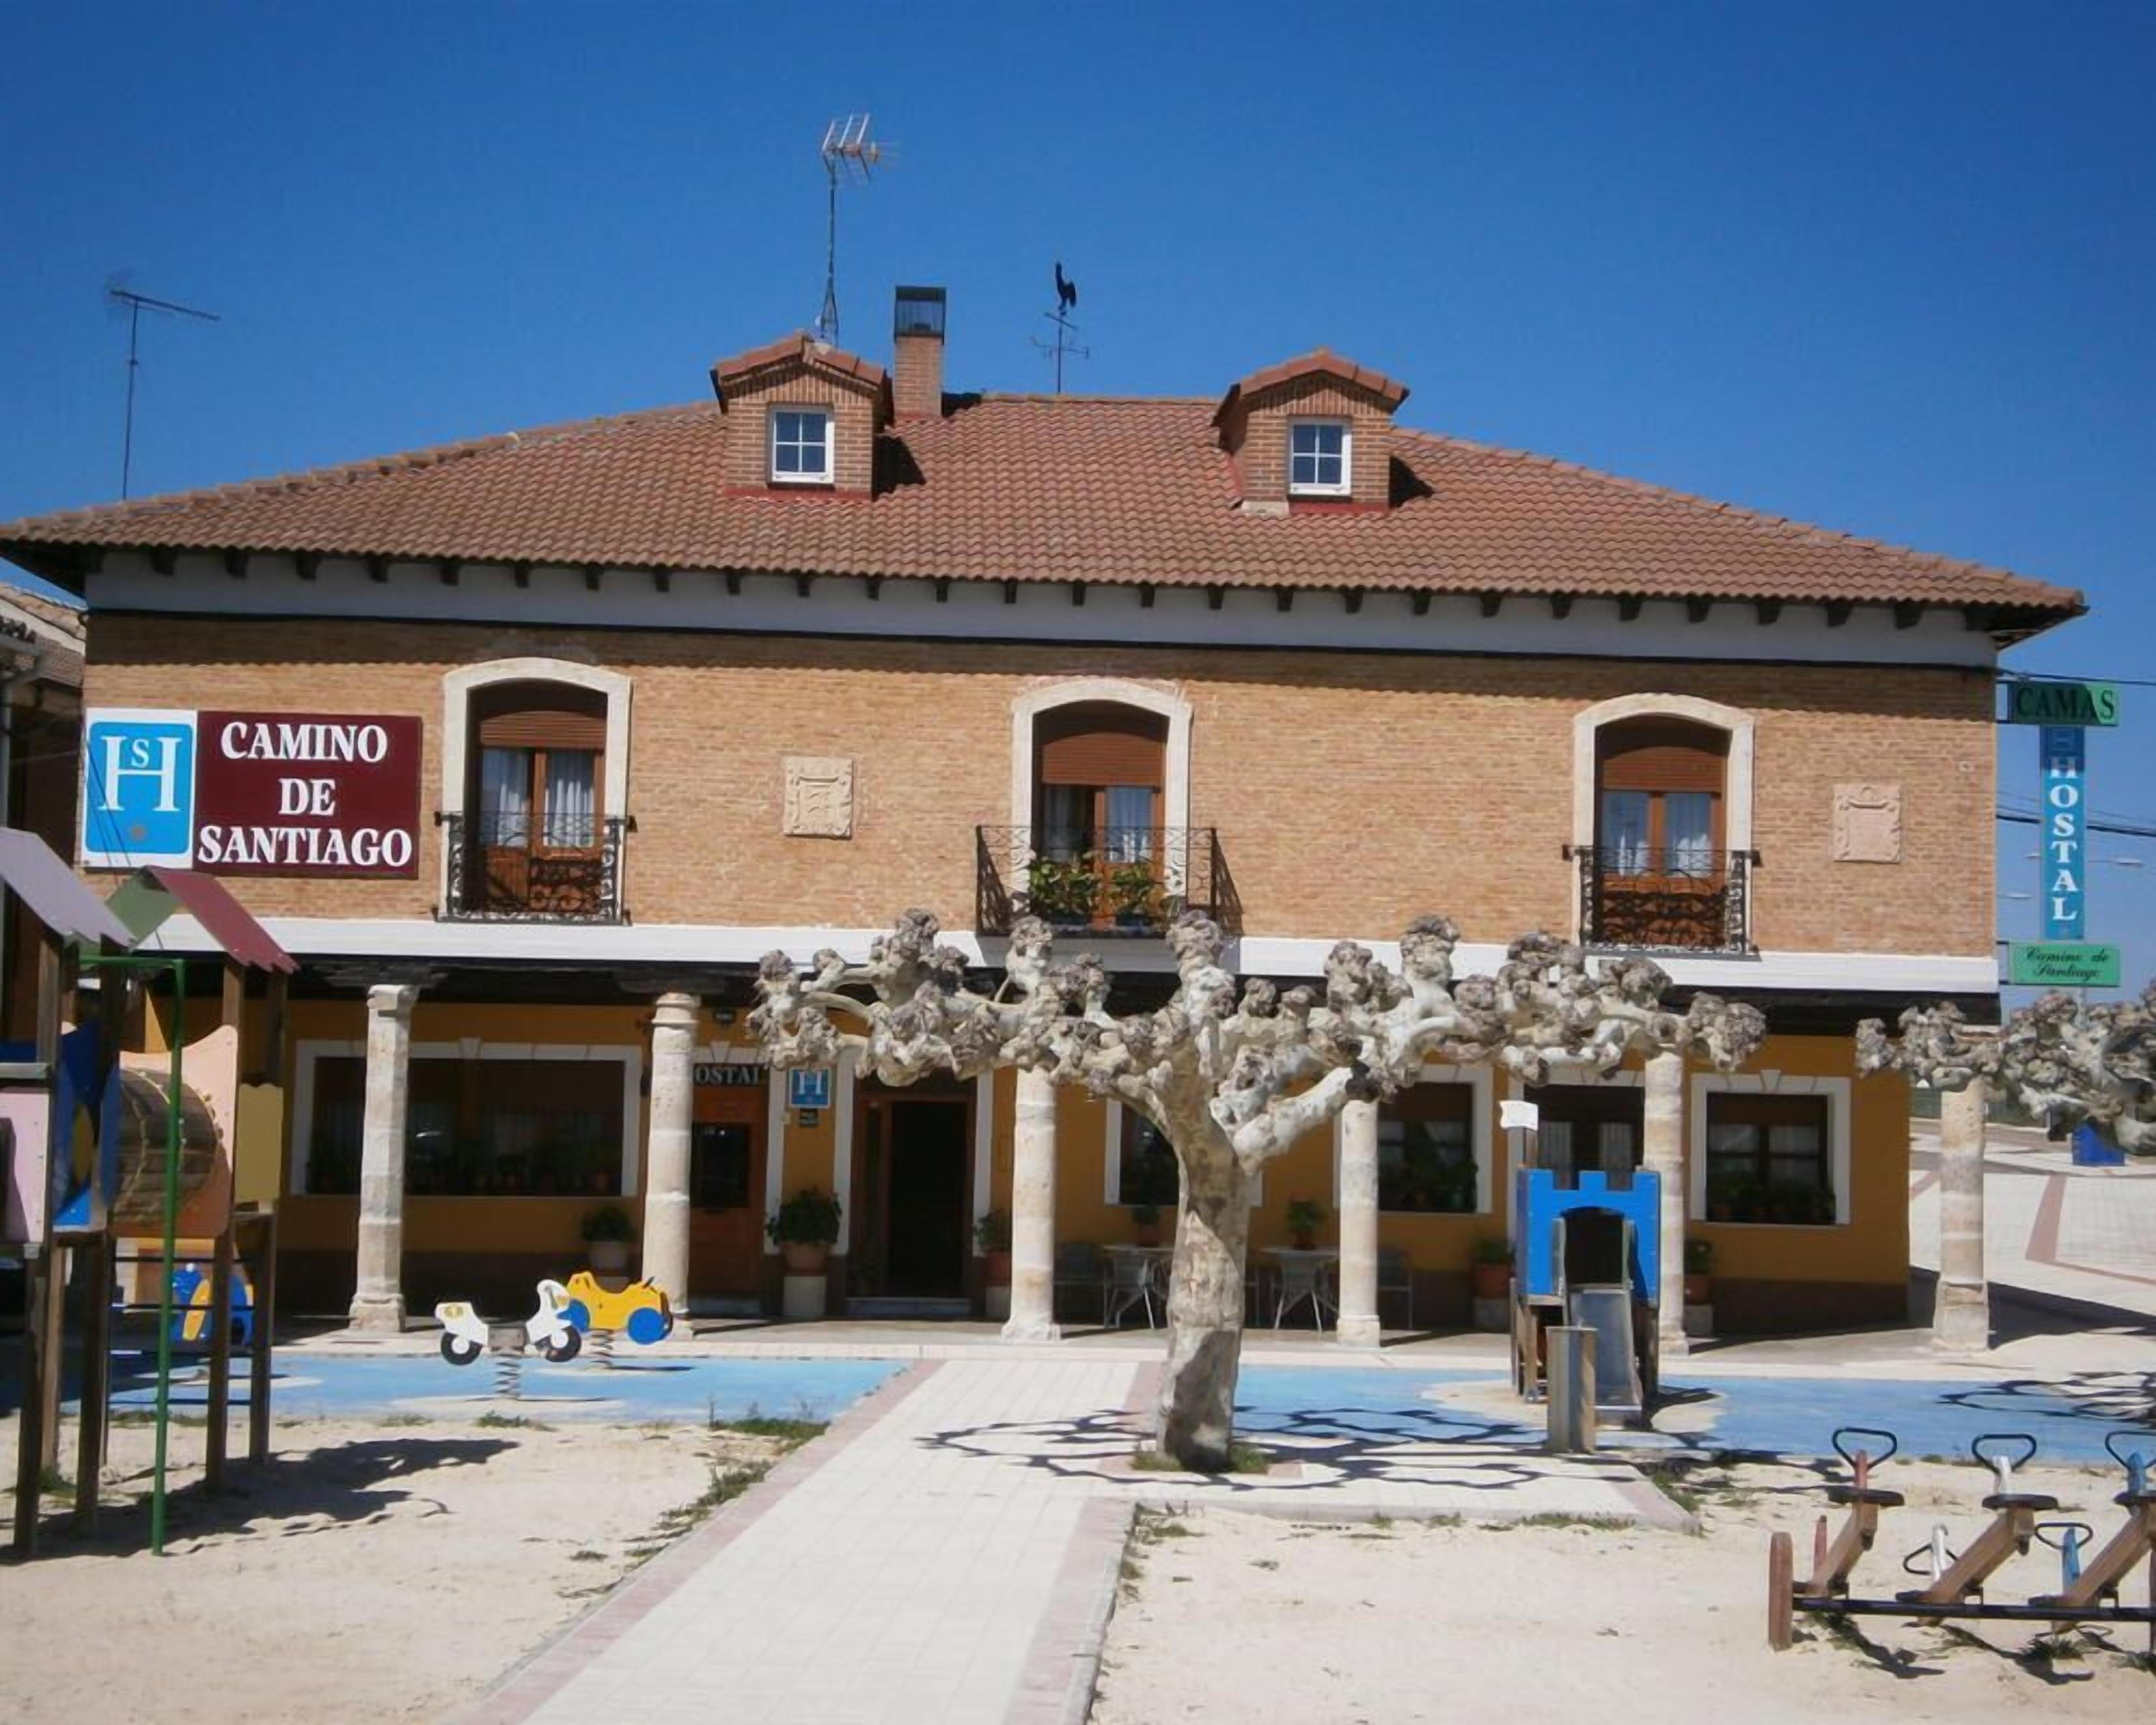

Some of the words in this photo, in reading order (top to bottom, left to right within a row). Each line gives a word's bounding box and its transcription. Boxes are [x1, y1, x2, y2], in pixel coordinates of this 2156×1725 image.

[2016, 687, 2114, 720] CAMAS
[221, 721, 388, 763] CAMINO
[278, 778, 336, 816] DE
[198, 825, 413, 867] SANTIAGO
[2049, 756, 2079, 921] HOSTAL
[2091, 948, 2110, 962] de
